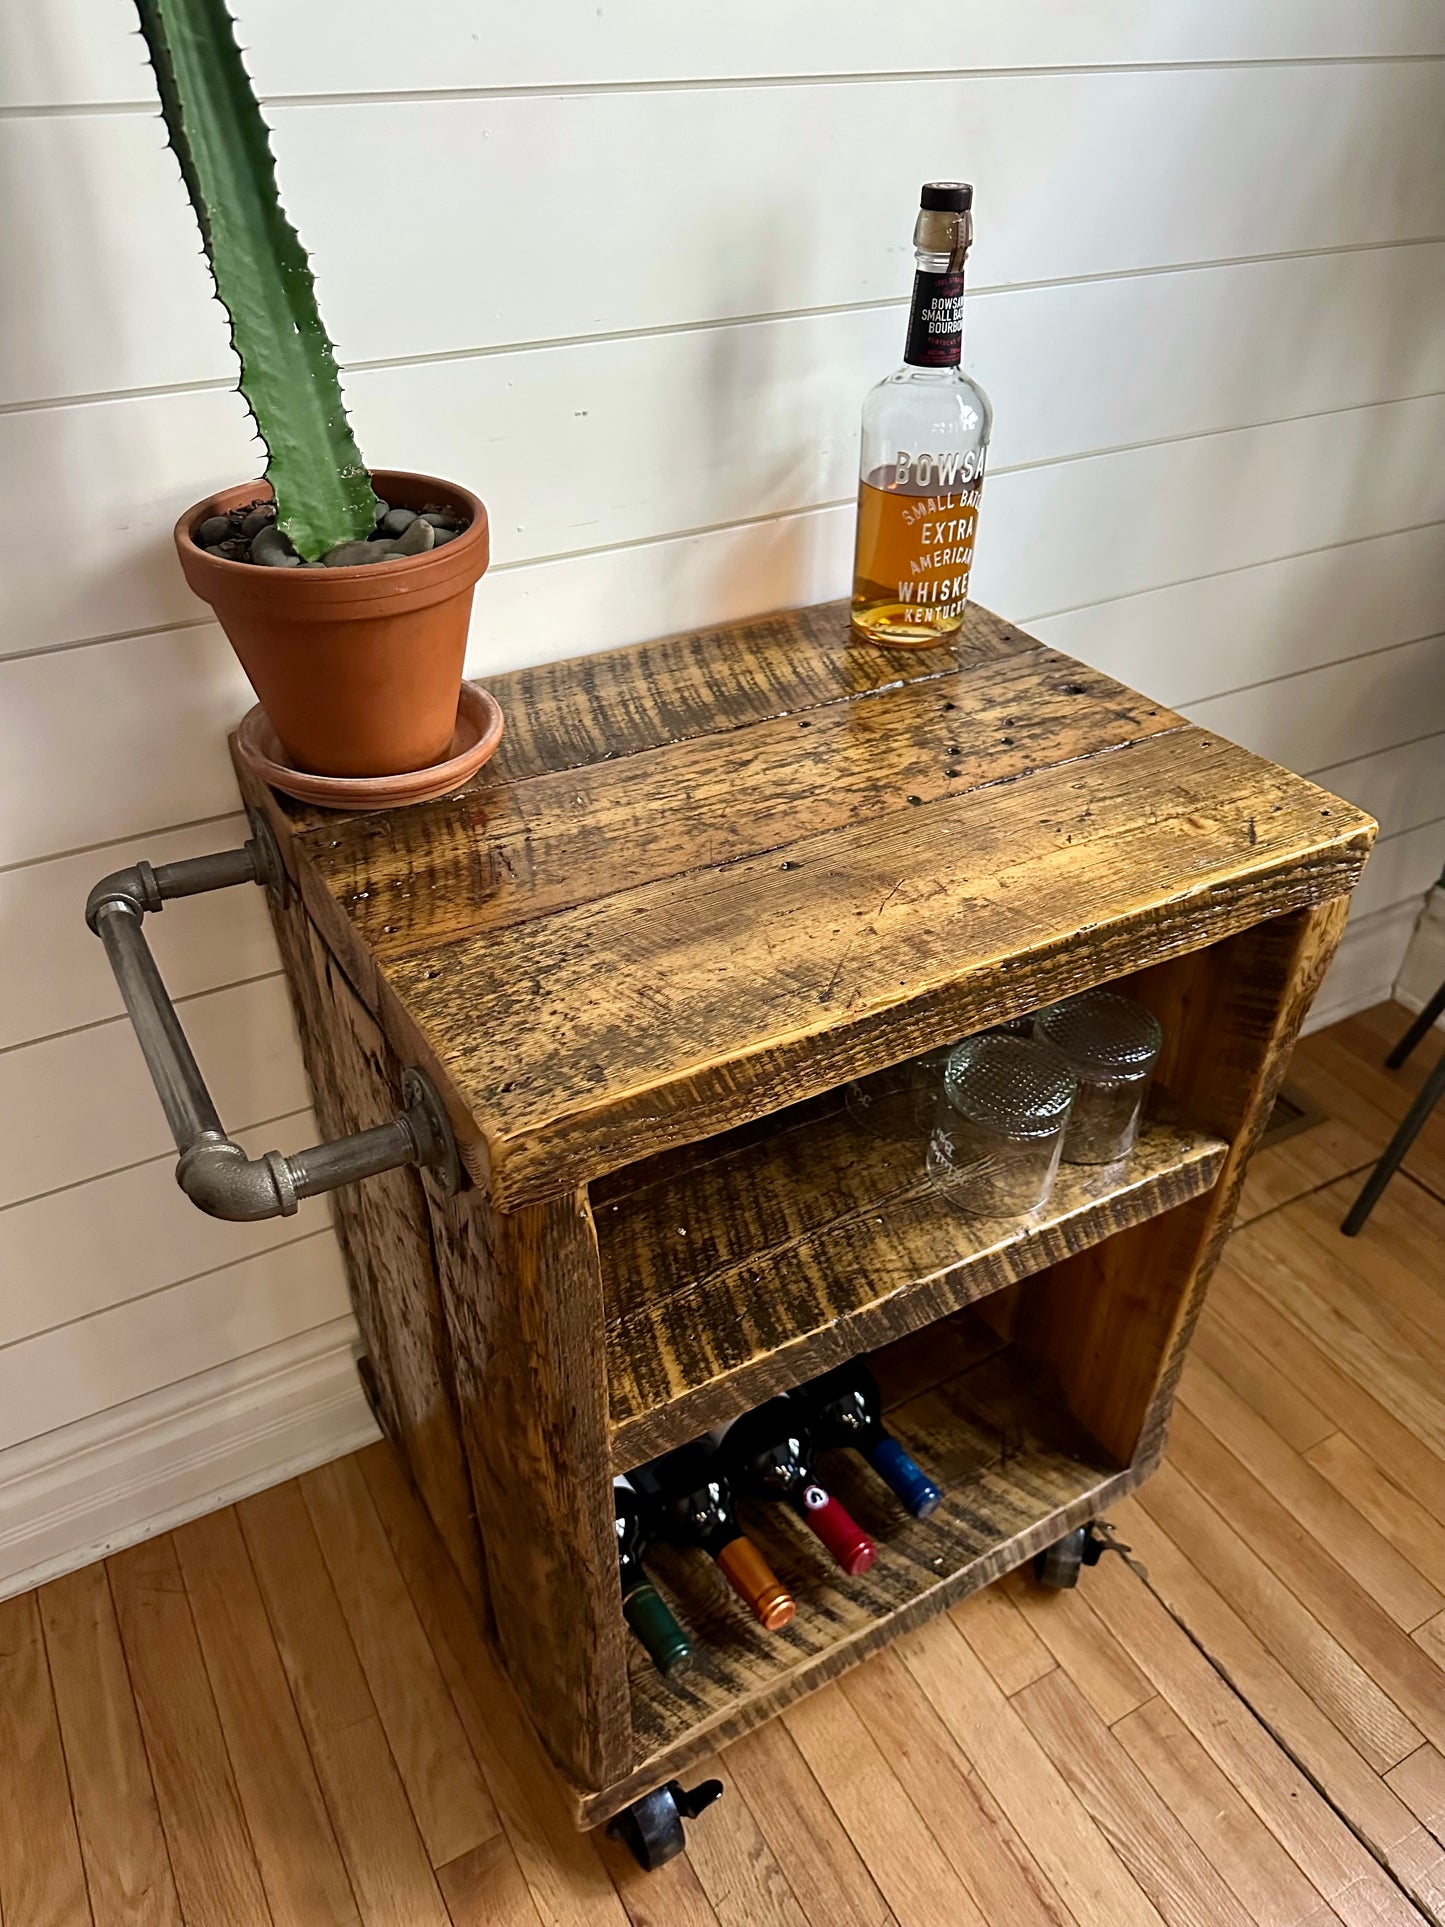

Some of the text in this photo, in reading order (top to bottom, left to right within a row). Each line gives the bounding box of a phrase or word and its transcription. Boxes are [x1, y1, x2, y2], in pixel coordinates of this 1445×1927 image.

[921, 308, 963, 321] SMALL BA
[931, 297, 963, 309] BOWSA
[928, 320, 962, 333] BOURBO
[895, 447, 985, 486] BOWSA
[902, 492, 954, 526] SMALL
[921, 516, 973, 544] EXTRA
[898, 572, 969, 603] WHISKE
